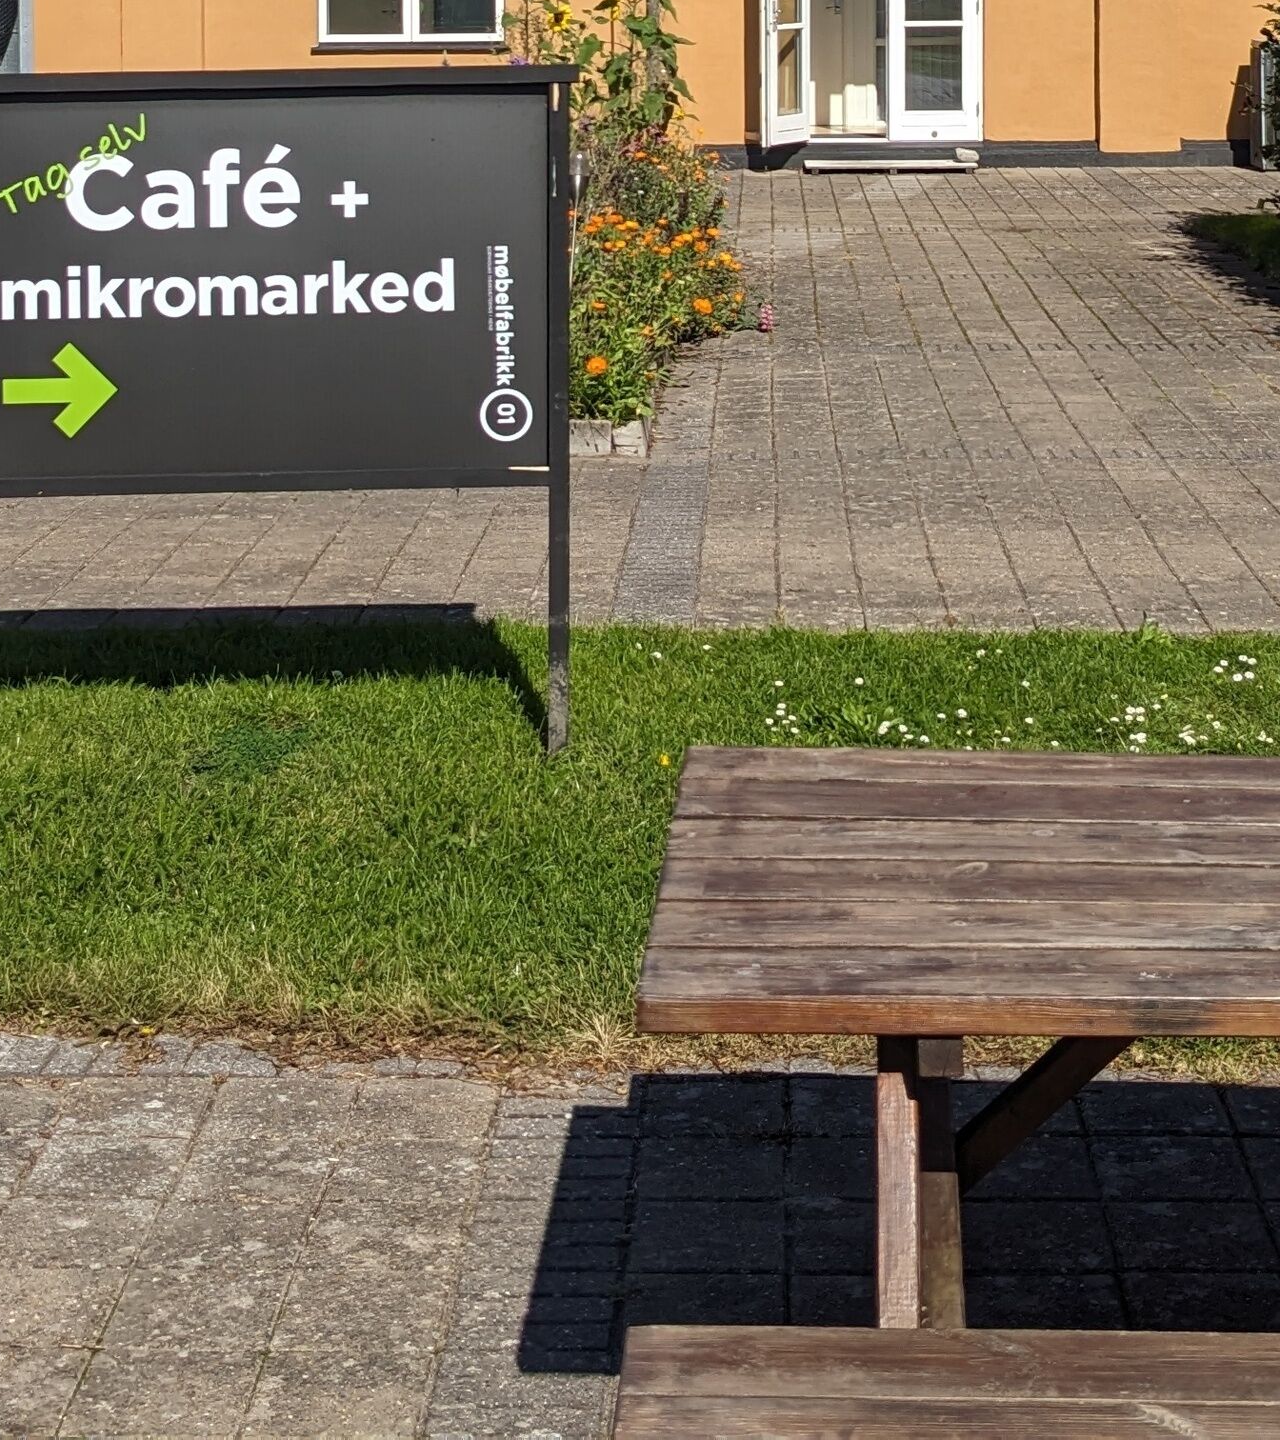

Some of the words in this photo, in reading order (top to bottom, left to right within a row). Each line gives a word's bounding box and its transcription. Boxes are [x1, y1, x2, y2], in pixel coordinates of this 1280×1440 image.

[80, 112, 146, 170] selv
[64, 143, 301, 232] Café
[0, 257, 456, 321] mikromarked
[493, 245, 516, 387] møbelfabrikk
